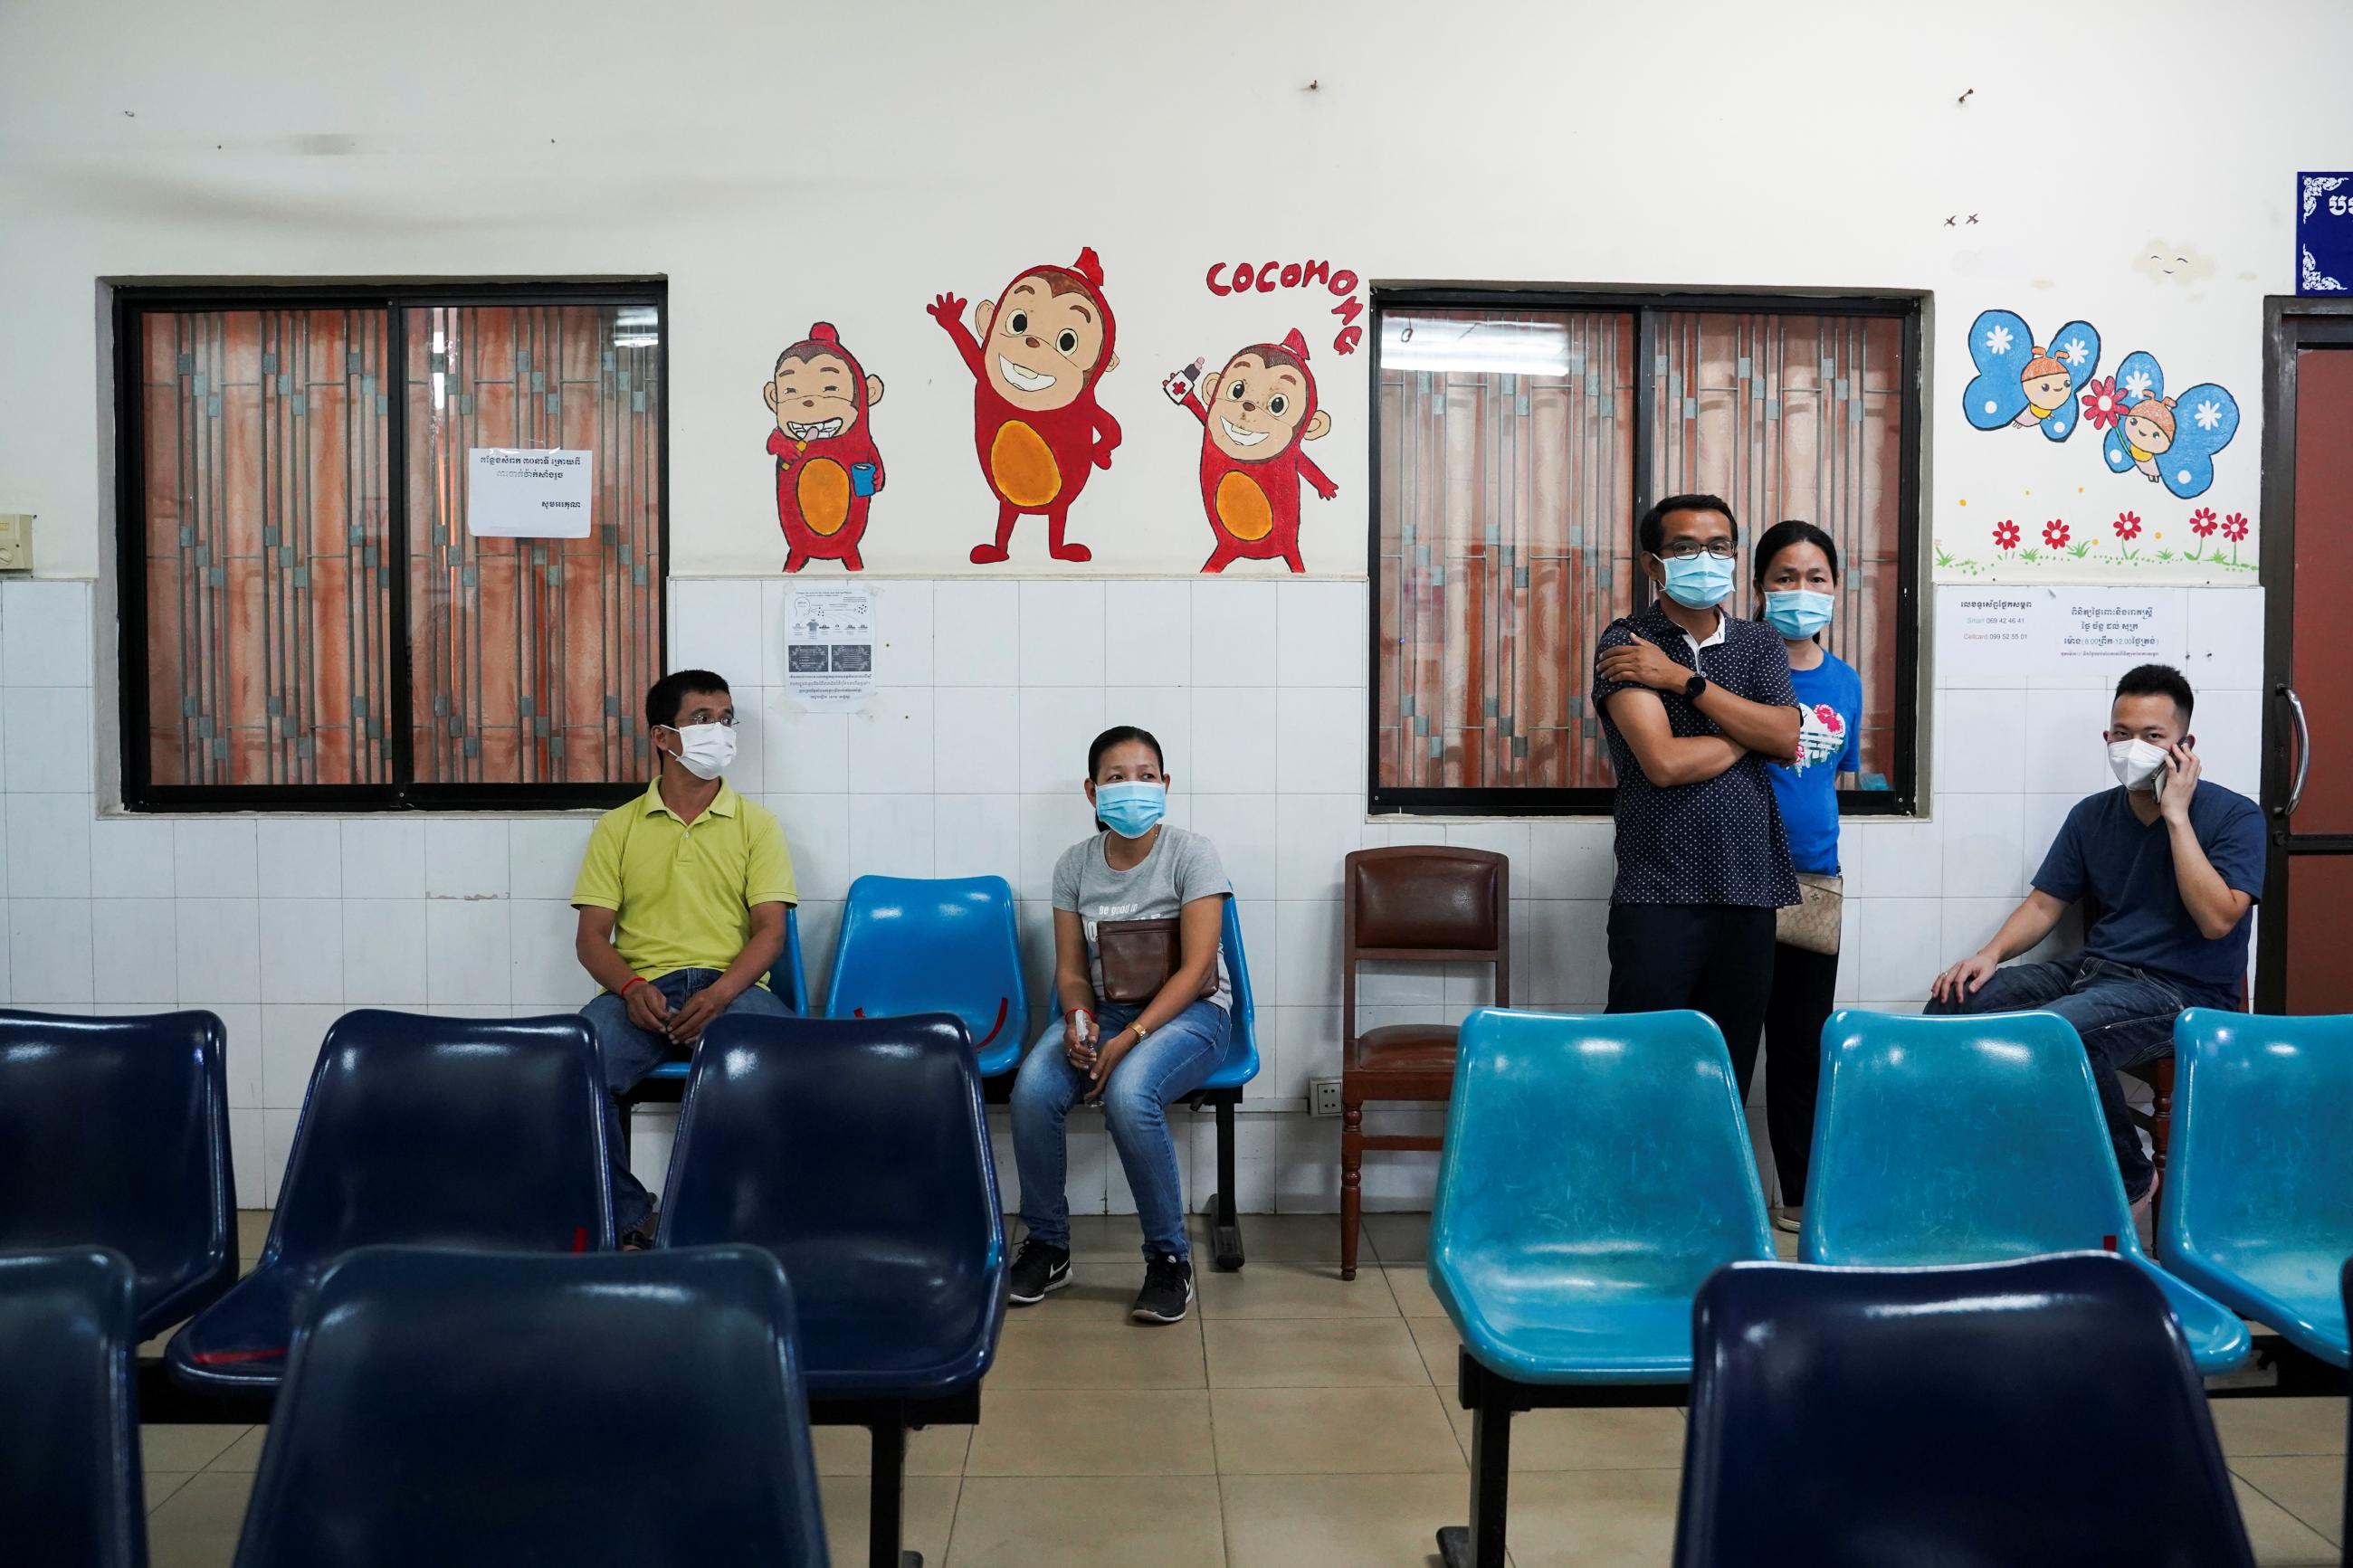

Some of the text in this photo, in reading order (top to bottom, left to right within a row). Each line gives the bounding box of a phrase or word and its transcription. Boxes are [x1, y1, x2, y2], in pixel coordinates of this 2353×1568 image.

[1206, 260, 1364, 356] COCOMONG
[1989, 632, 2001, 641] 099
[1099, 905, 1110, 915] Be
[1110, 904, 1129, 916] good
